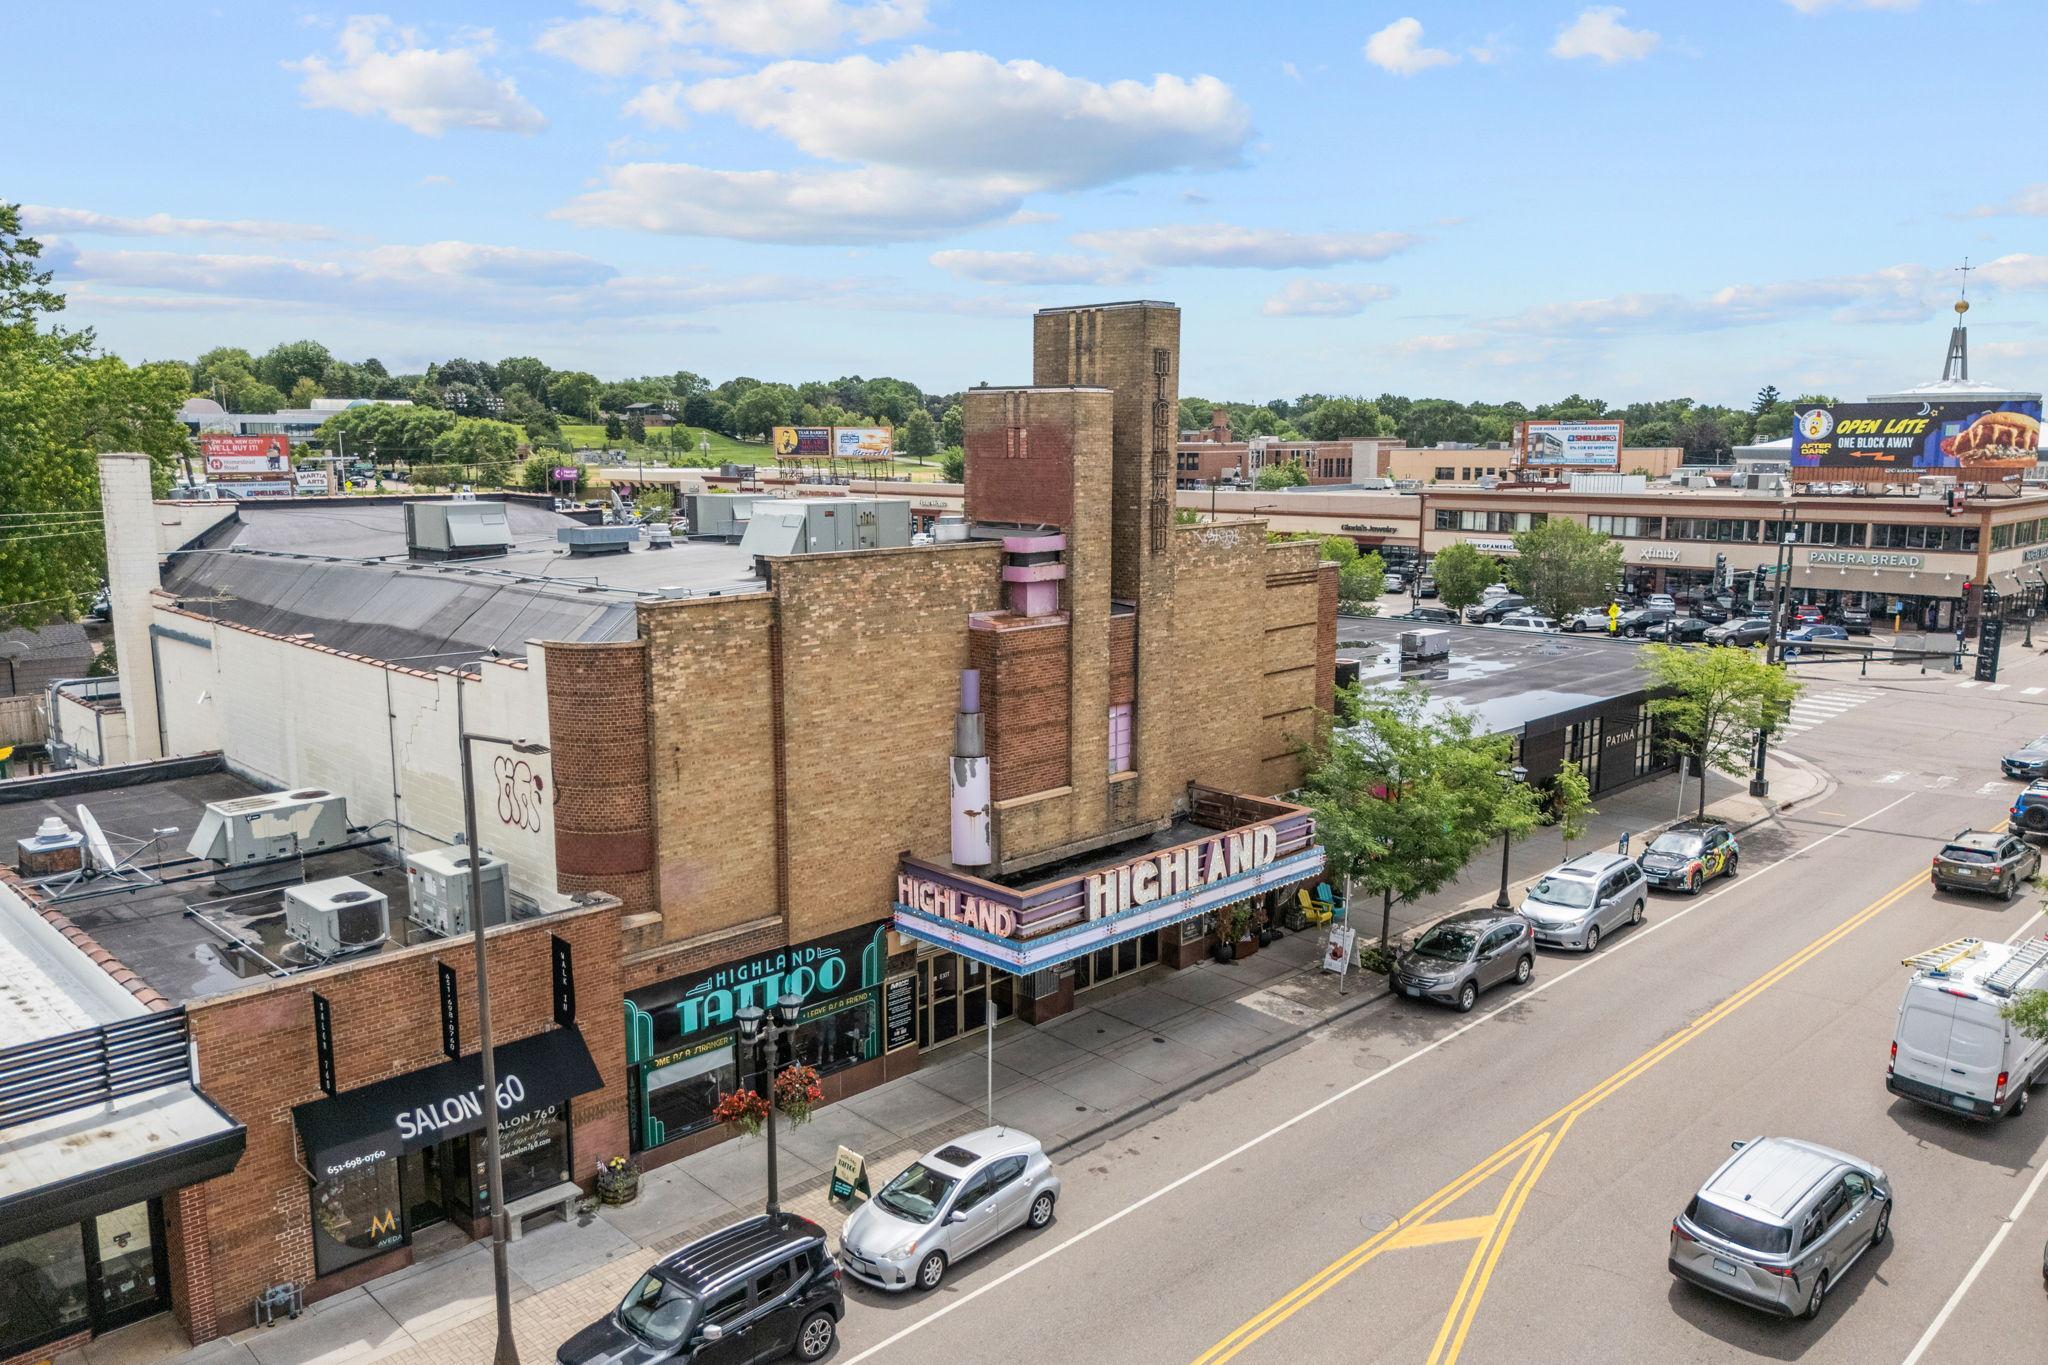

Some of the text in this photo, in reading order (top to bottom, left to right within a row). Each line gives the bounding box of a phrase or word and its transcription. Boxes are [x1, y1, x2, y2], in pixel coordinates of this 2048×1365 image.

[1836, 418, 1882, 434] OPEN
[1883, 418, 1930, 434] LATE
[1838, 436, 1914, 448] ONE BLOCK AWAY
[1810, 552, 1920, 566] PANERA BREAD
[1606, 728, 1635, 748] PATINA
[1085, 824, 1278, 922] HIGHLAND
[898, 874, 1013, 938] HIGHLAND
[560, 951, 568, 986] WALK
[716, 948, 815, 988] HIGHLAND
[939, 971, 950, 980] EXIT
[676, 956, 846, 1036] TATTOO
[807, 1006, 826, 1018] LEAVE
[829, 1002, 838, 1011] AS
[846, 992, 868, 1005] FRIEND
[694, 1037, 728, 1054] STRANGER
[395, 1074, 525, 1140] SALON 60
[498, 1105, 555, 1130] ALON 760
[327, 1150, 386, 1175] 651-698-0760
[378, 1234, 403, 1248] AVEDA
